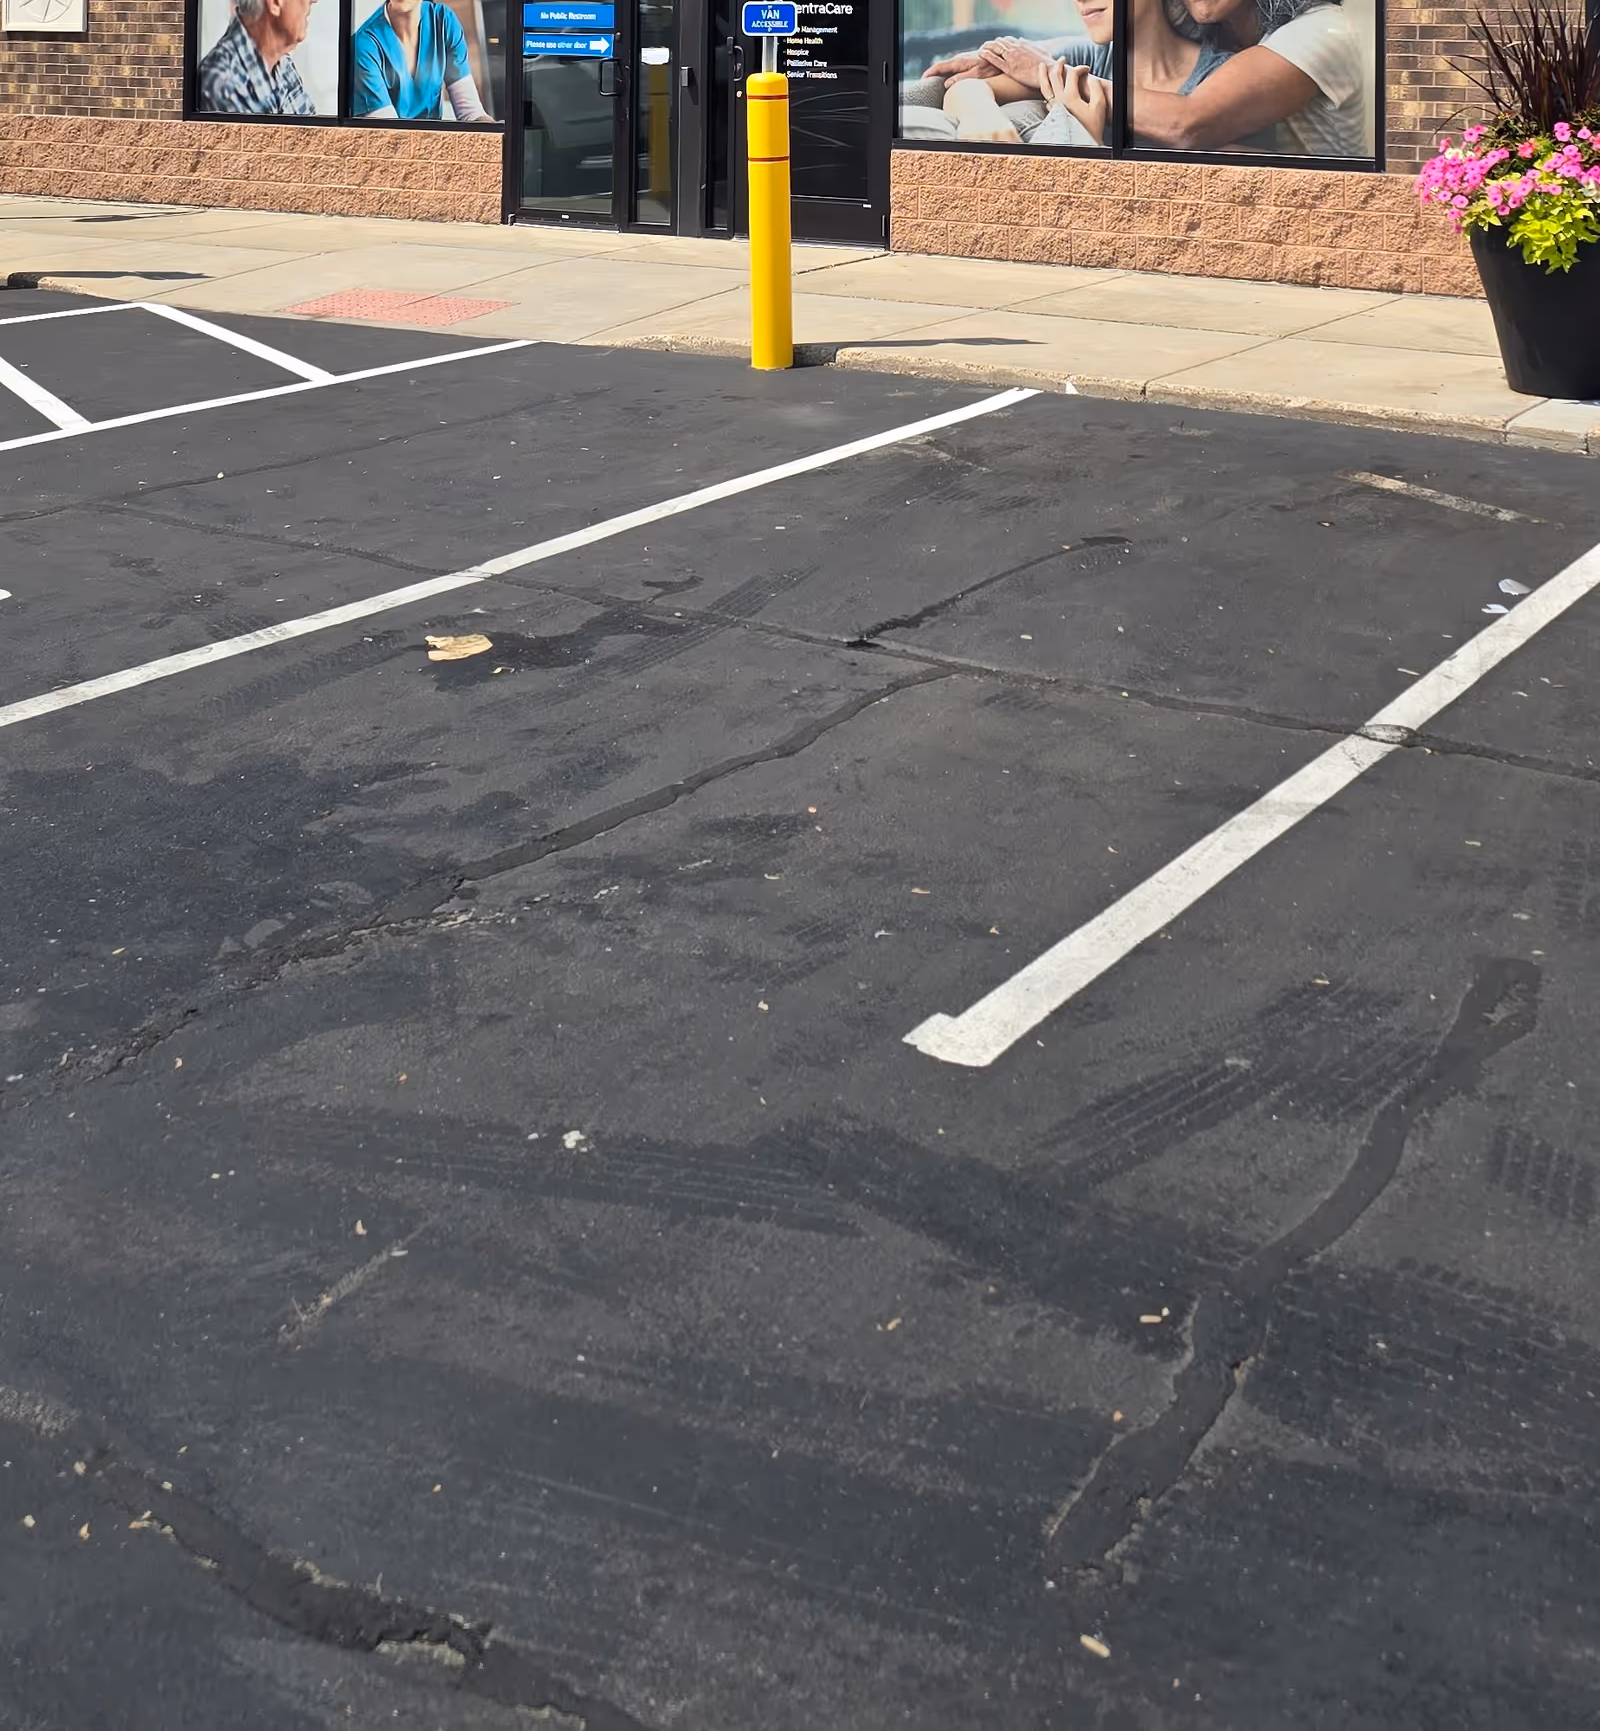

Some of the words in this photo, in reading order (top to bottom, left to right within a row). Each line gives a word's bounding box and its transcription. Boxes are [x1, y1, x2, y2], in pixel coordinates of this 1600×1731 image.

[796, 2, 853, 14] entraCare
[549, 12, 568, 20] Public
[761, 9, 780, 19] VAN
[751, 20, 789, 28] ACCESSIBLE
[801, 25, 838, 34] Management
[526, 40, 545, 48] Please
[573, 41, 587, 49] door
[786, 48, 810, 56] Hospice
[786, 59, 812, 67] Palliative
[813, 59, 828, 67] Care
[786, 70, 805, 78] Senior
[806, 70, 838, 79] Transitions
